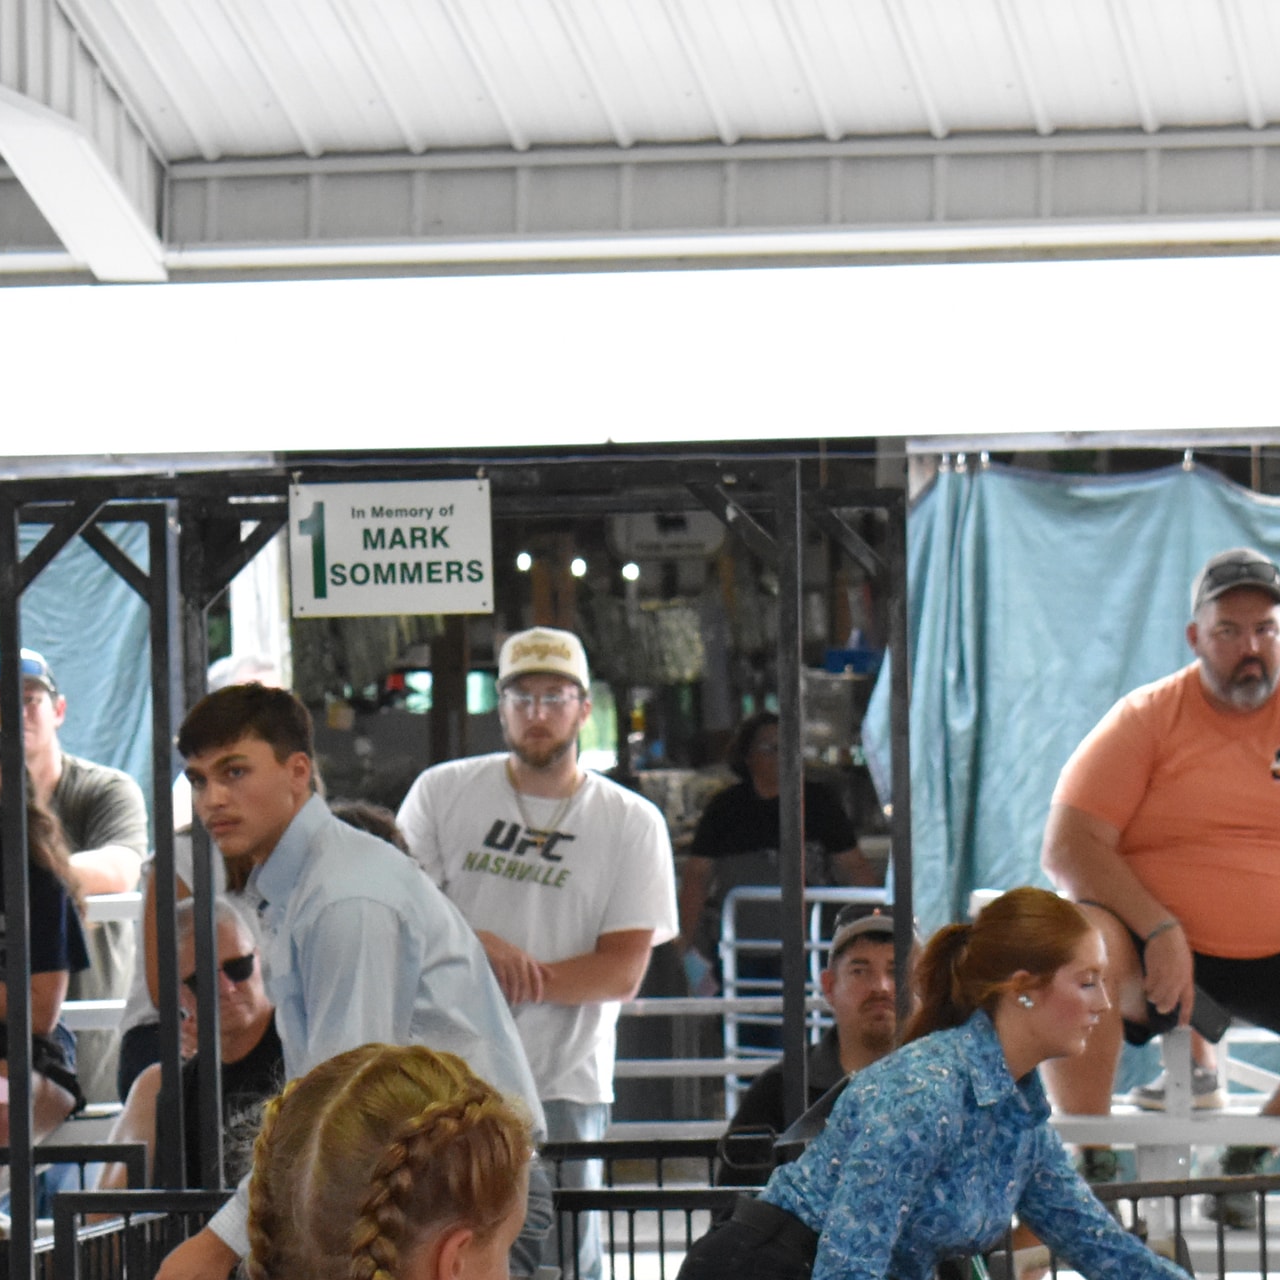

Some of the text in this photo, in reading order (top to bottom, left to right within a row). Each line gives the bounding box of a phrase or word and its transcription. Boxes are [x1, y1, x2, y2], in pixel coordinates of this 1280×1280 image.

[351, 504, 455, 520] In Memory of
[298, 501, 327, 599] 1
[363, 526, 450, 550] MARK
[330, 560, 484, 586] SOMMERS
[483, 819, 575, 862] UFC
